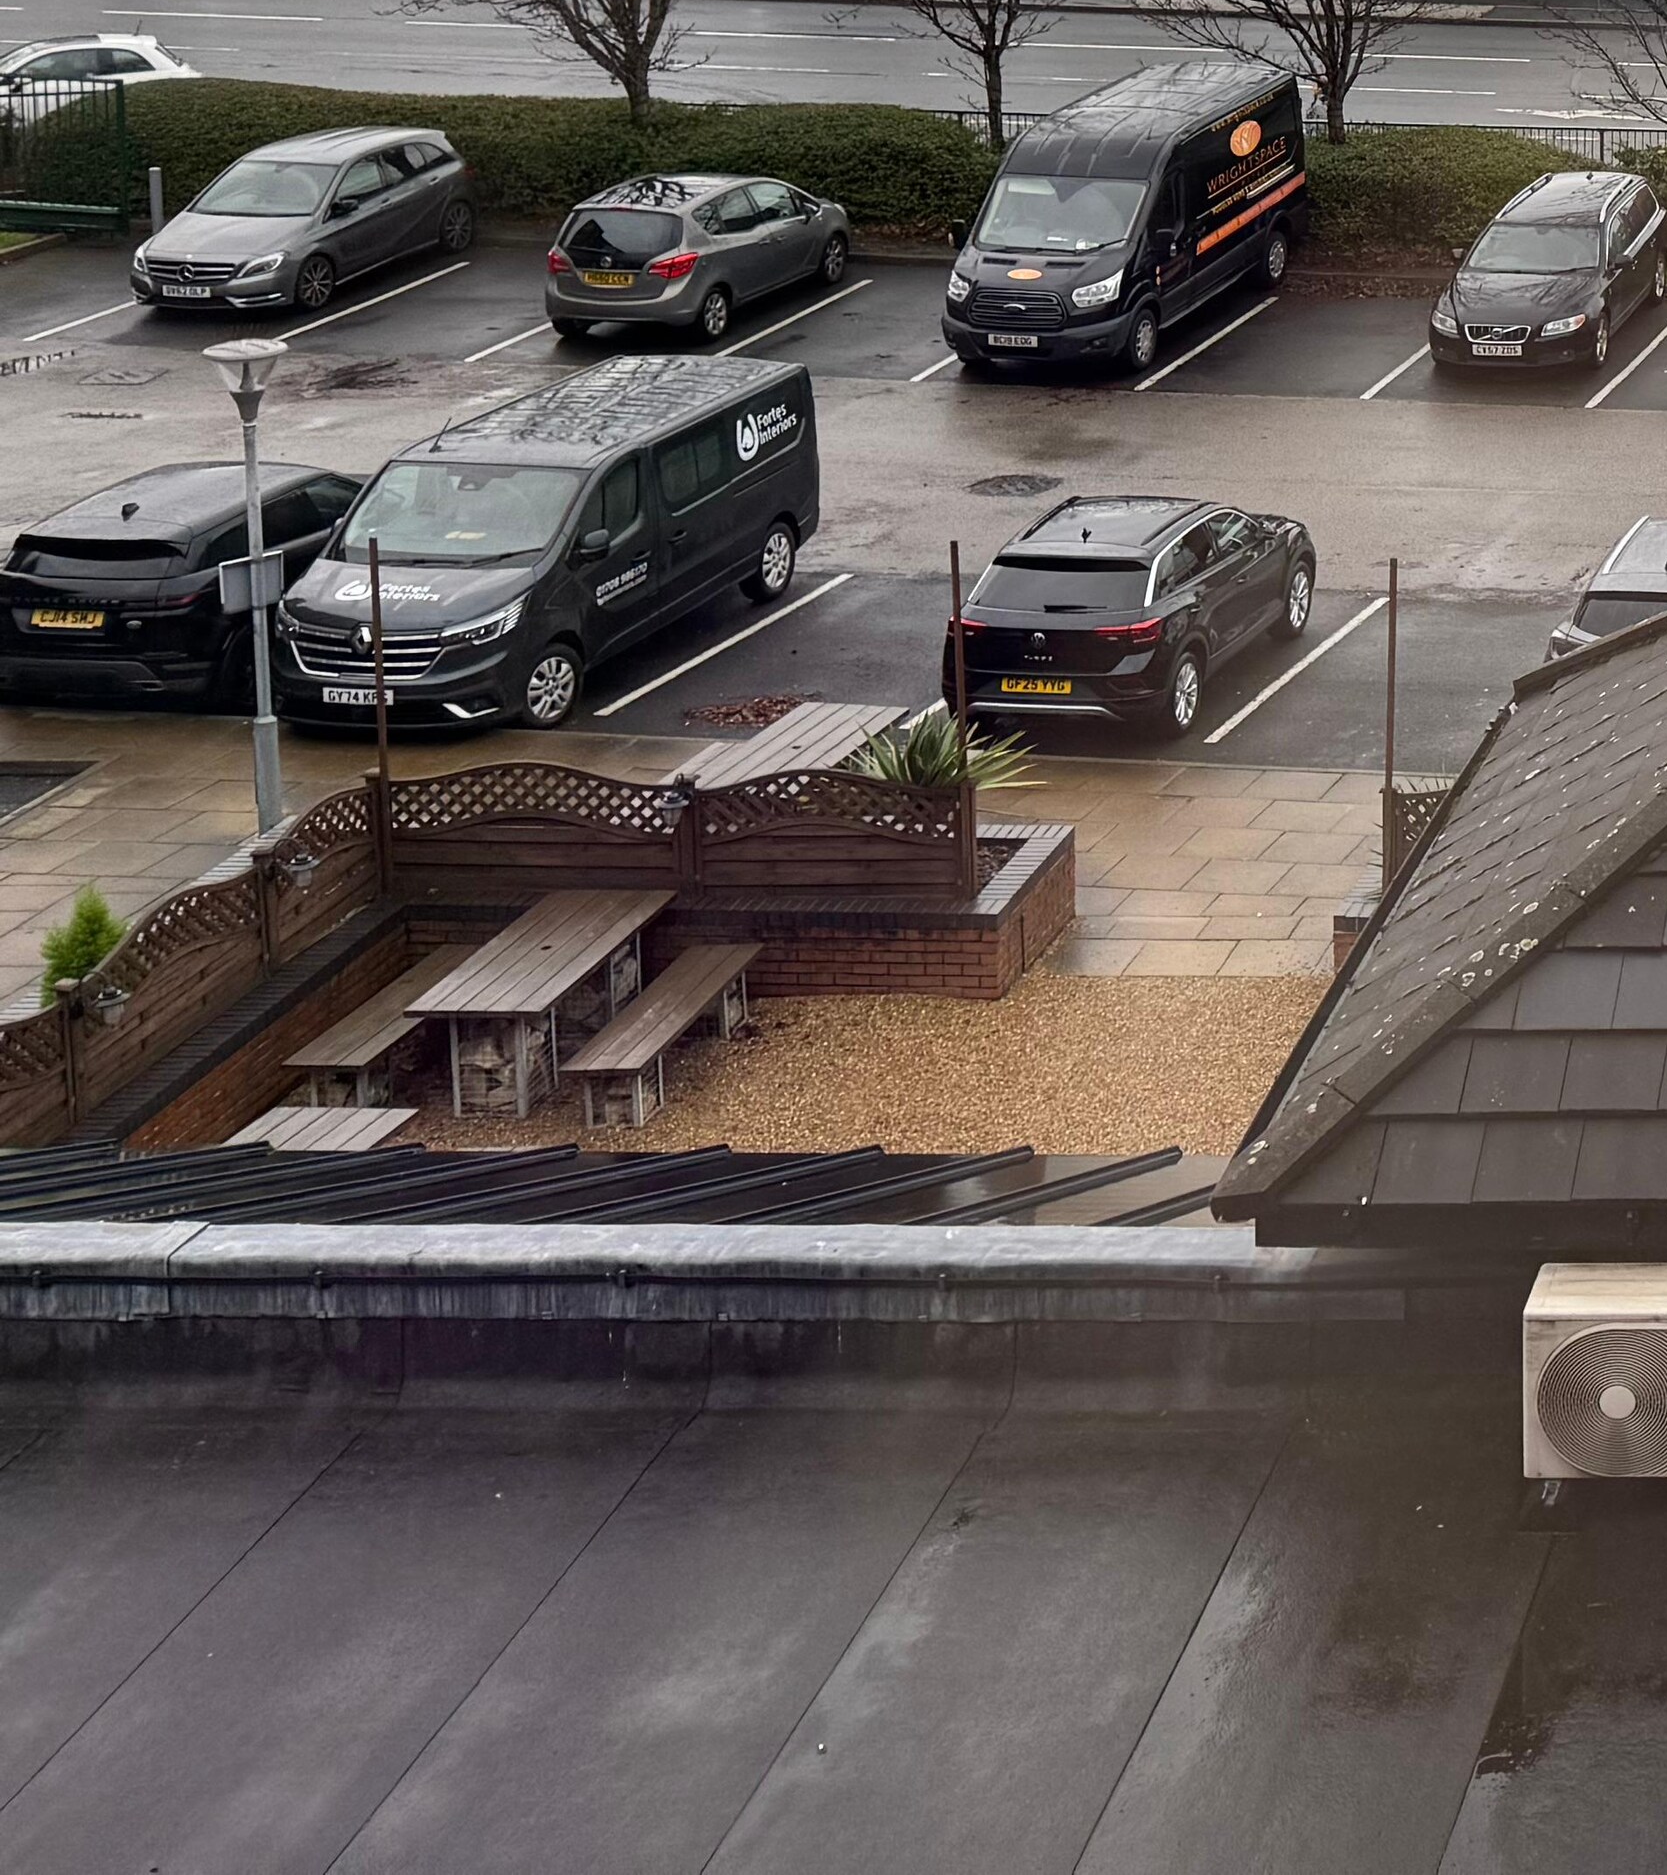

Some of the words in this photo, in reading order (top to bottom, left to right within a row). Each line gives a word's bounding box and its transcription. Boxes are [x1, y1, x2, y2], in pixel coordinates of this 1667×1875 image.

[1207, 136, 1287, 193] WRIGHTSPACE
[757, 404, 787, 430] Fortes
[760, 413, 797, 445] Interiors
[379, 591, 441, 602] nteriors
[40, 610, 67, 623] CJ14
[328, 690, 360, 702] GY74
